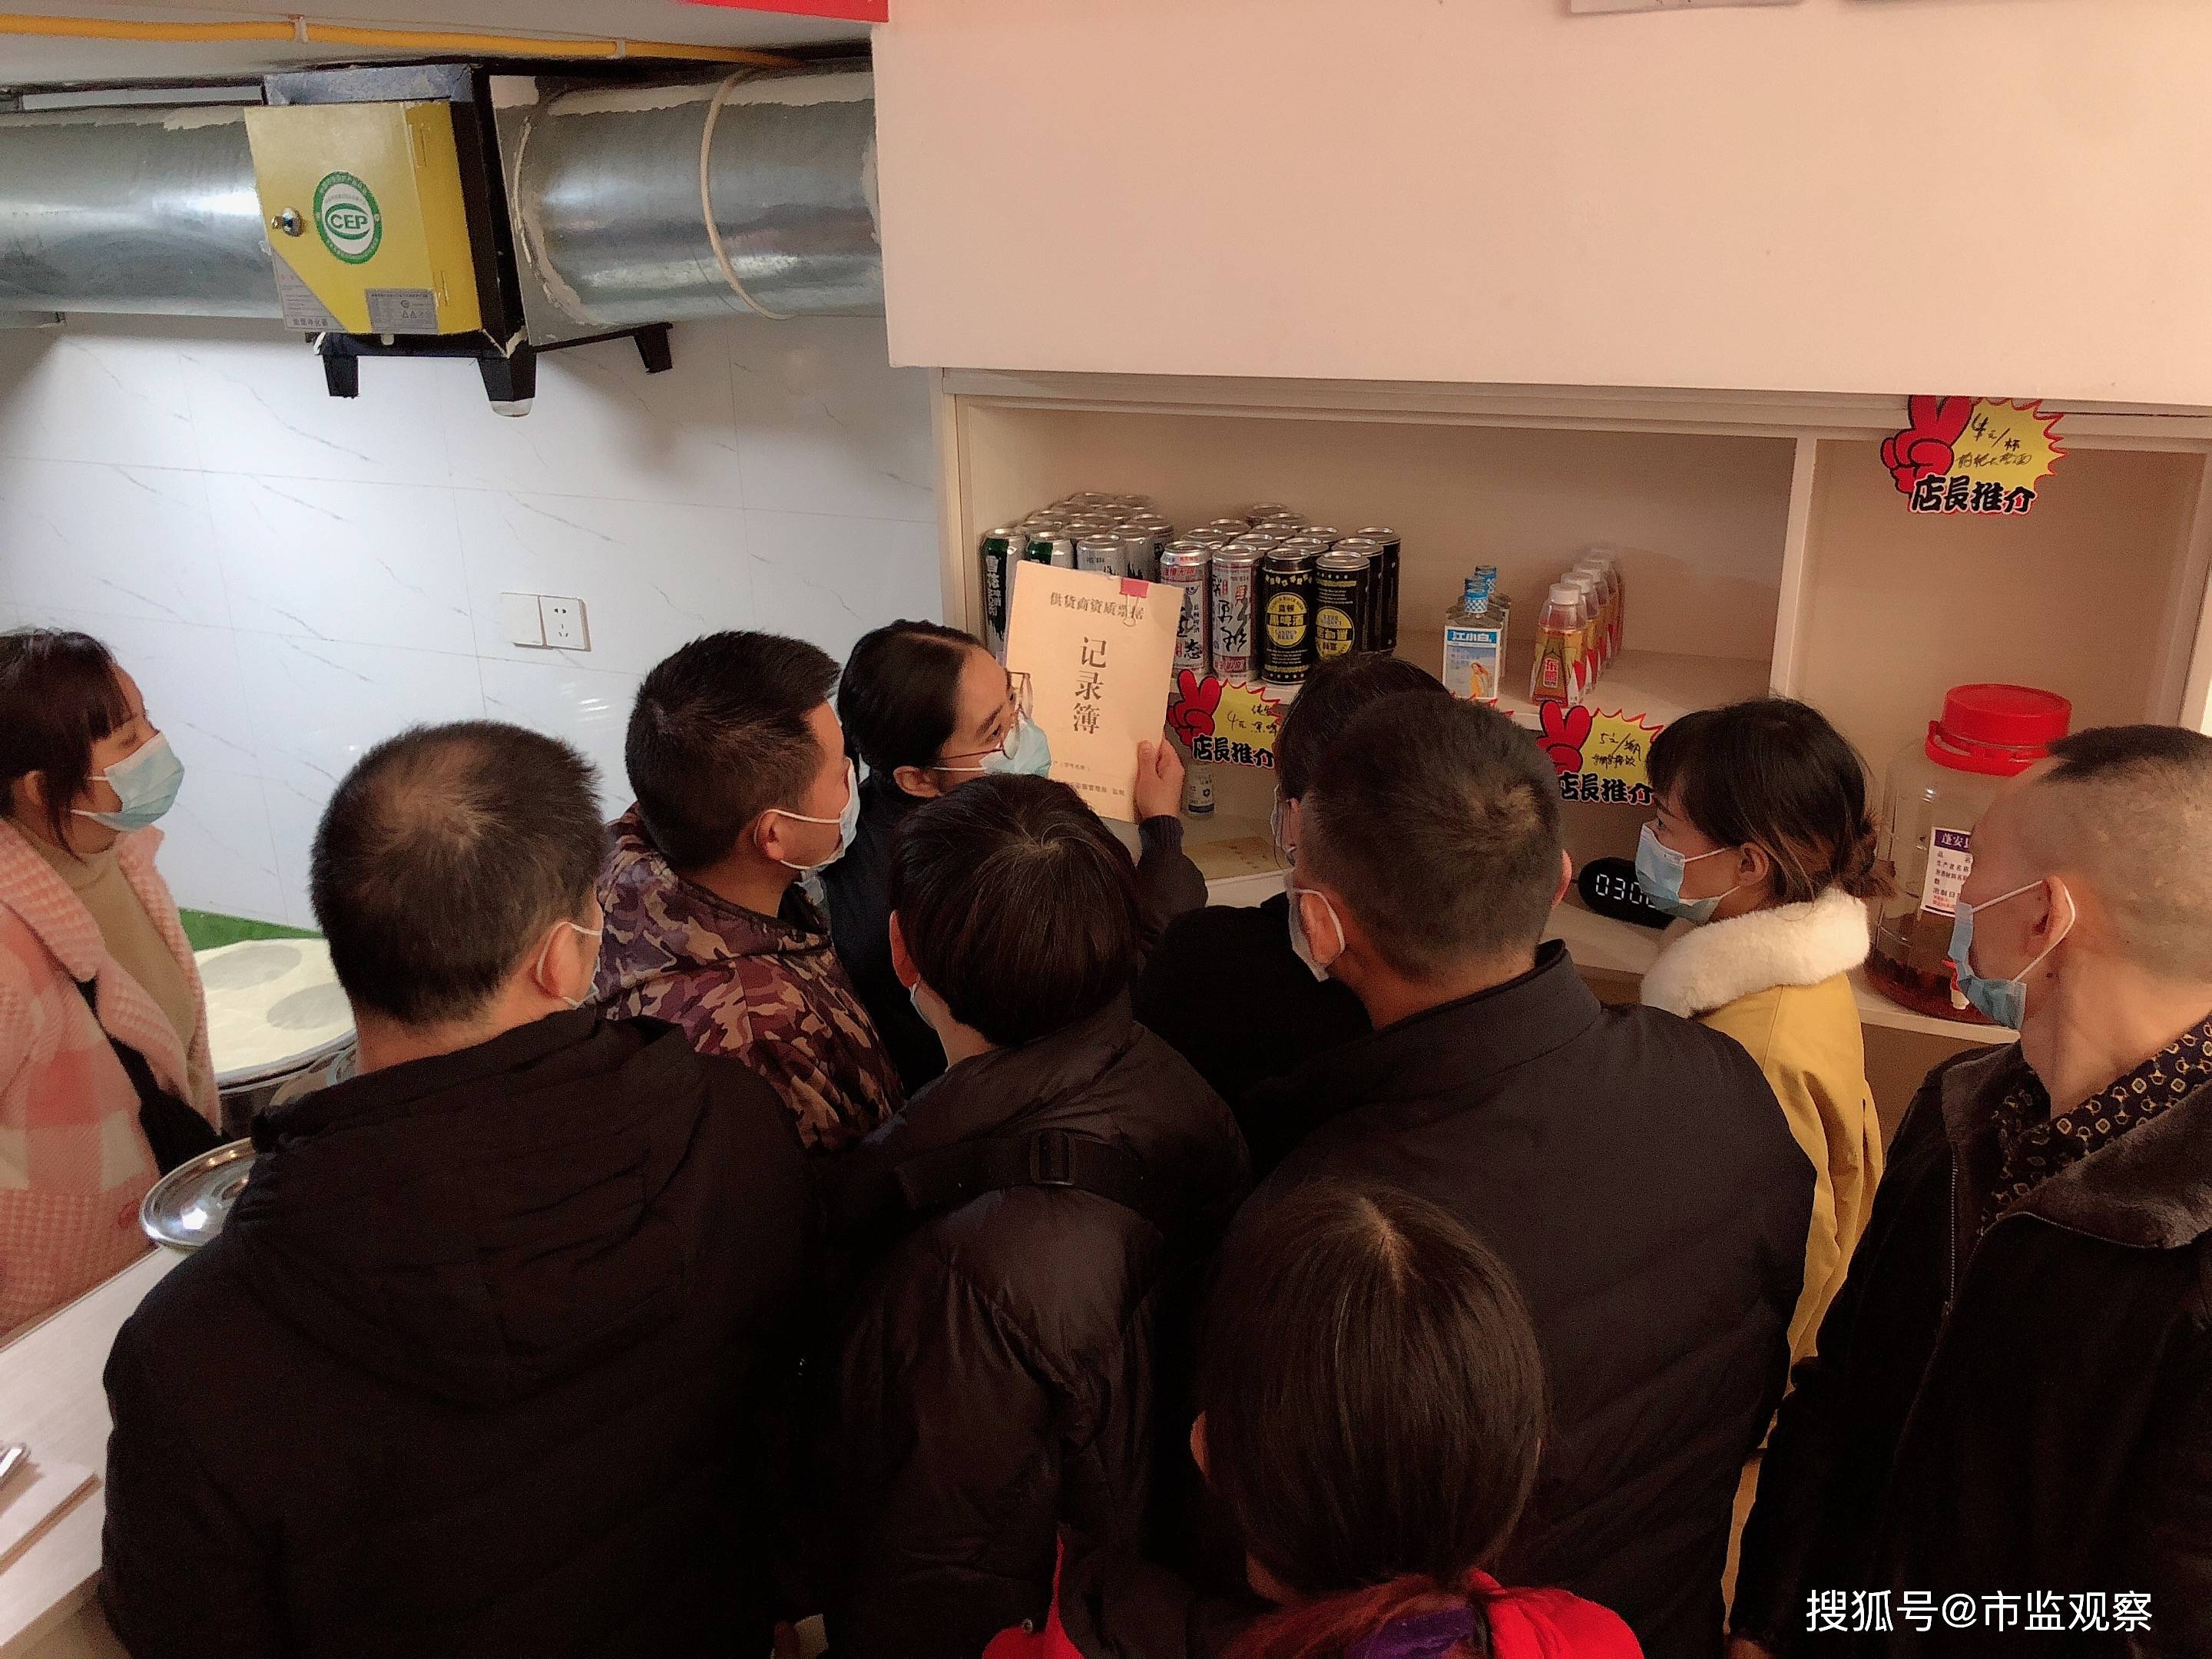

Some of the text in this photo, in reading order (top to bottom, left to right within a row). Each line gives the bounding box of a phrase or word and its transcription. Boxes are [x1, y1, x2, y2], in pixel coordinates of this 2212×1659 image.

[331, 214, 368, 229] CEP
[1911, 474, 2036, 514] 店長推介
[1452, 631, 1489, 642] 江小白
[1073, 636, 1107, 735] 记录簿
[1192, 734, 1275, 768] 店長推介
[1560, 771, 1653, 804] 店長推介
